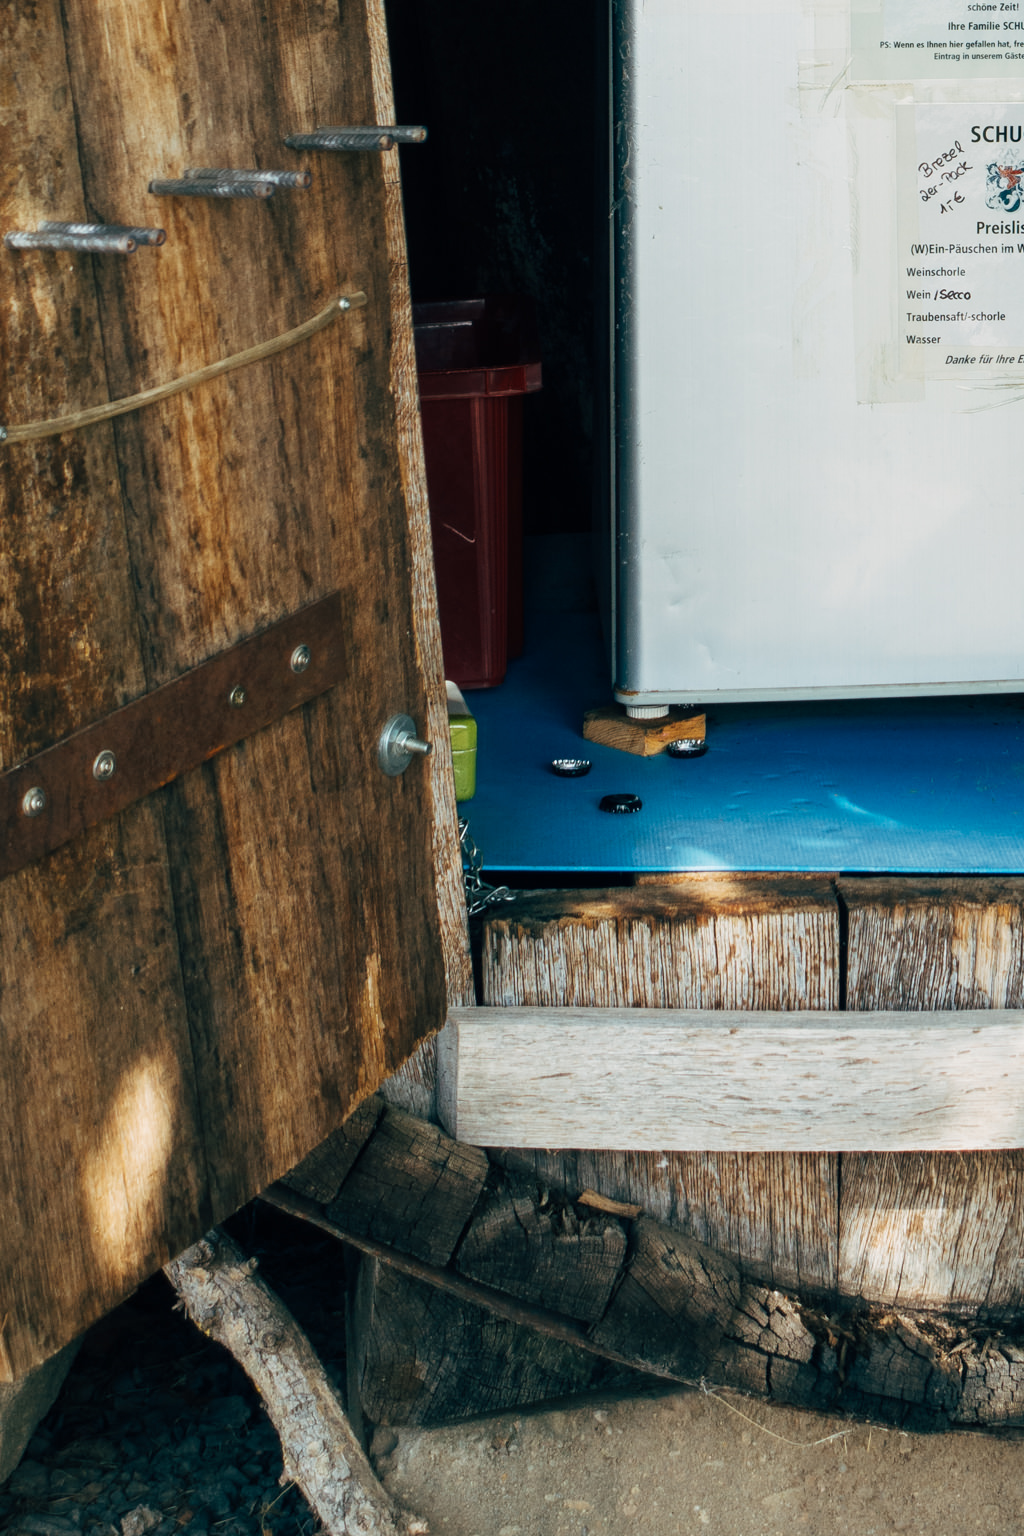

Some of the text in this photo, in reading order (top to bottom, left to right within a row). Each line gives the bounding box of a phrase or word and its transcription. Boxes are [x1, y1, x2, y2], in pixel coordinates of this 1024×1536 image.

[967, 2, 1018, 11] schöne Zeit!
[948, 21, 965, 30] Ihre
[968, 21, 1000, 30] Familie
[933, 52, 960, 61] Eintrag
[918, 140, 965, 178] Brezel
[910, 243, 997, 255] (W)Ein-Päuschen
[1001, 243, 1013, 253] im
[906, 266, 965, 276] Weinschorle
[905, 289, 930, 299] Wein
[906, 310, 1005, 321] Traubensaft/-schorle
[905, 334, 941, 344] Wasser
[945, 354, 976, 364] Danke
[978, 353, 993, 363] für
[995, 353, 1015, 363] Ihre
